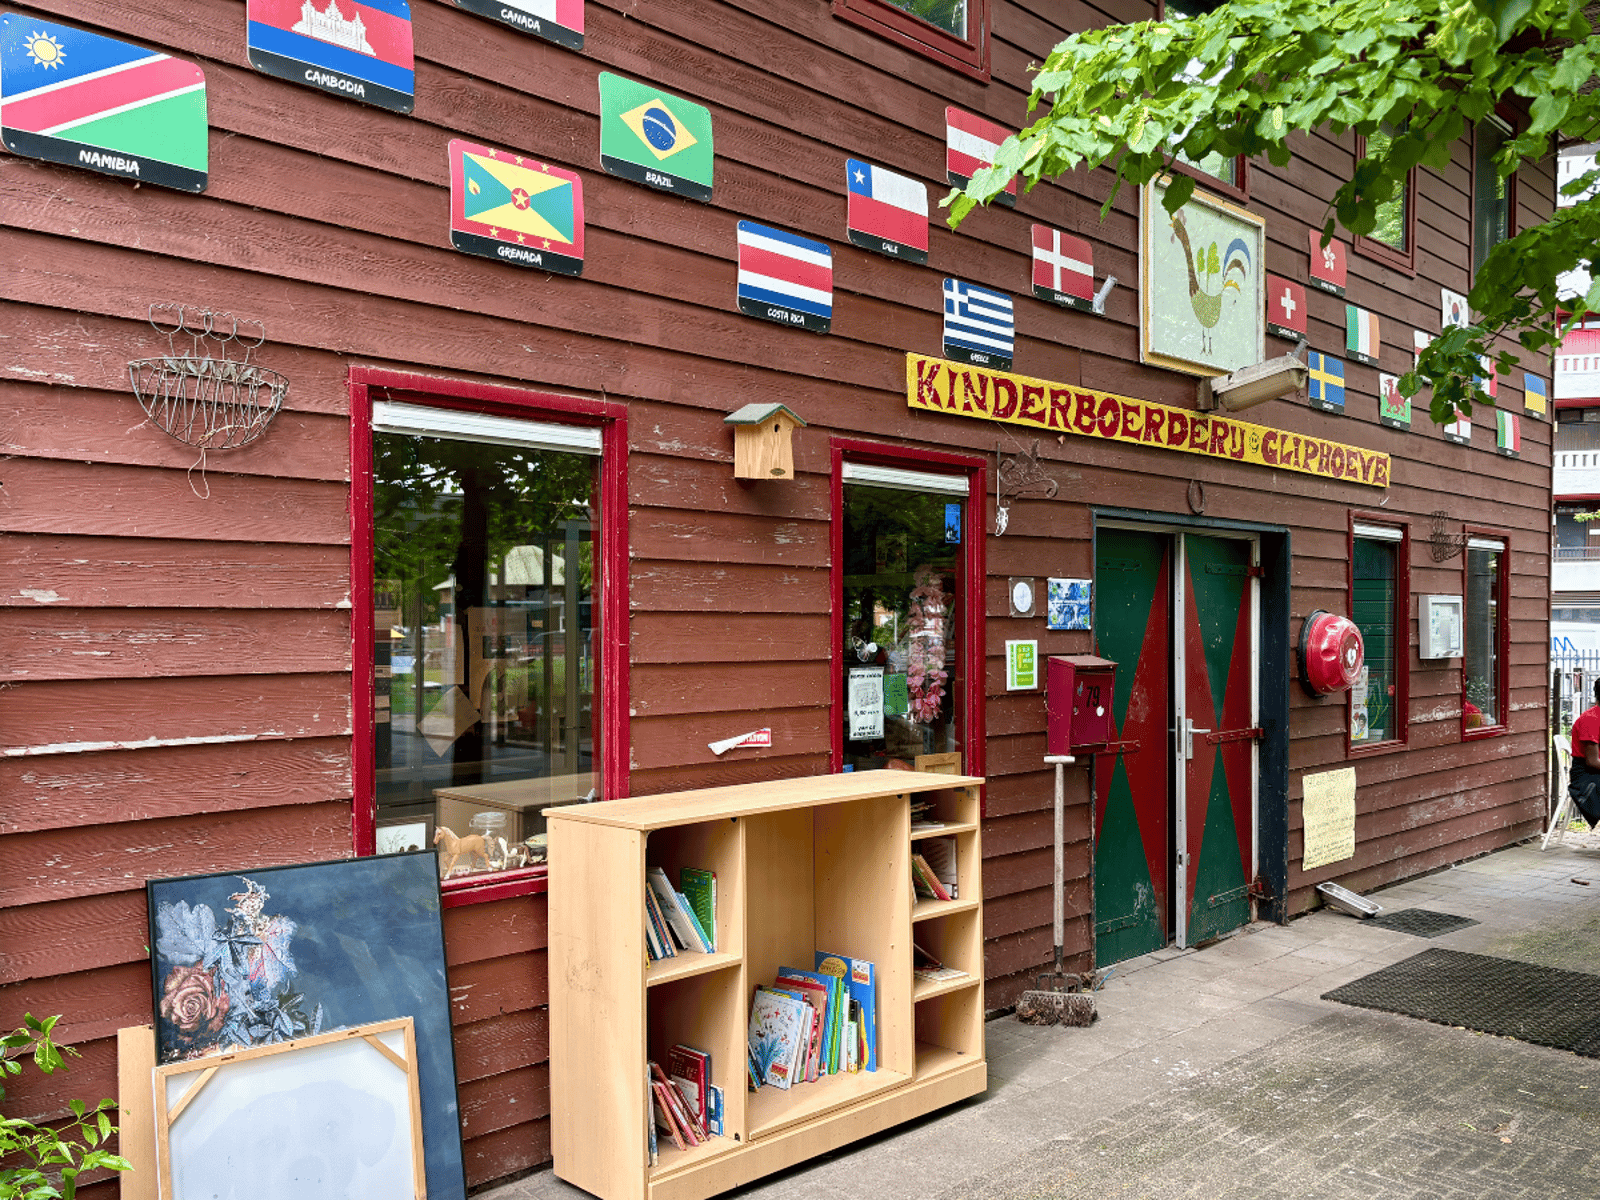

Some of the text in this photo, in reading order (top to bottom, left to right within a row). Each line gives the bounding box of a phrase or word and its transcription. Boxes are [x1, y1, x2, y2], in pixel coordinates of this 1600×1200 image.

[500, 8, 541, 32] CANADA
[304, 69, 365, 98] CAMBODIA
[79, 150, 140, 176] NAMIBIA
[645, 171, 674, 188] BRAZIL
[497, 246, 543, 266] GRENADA
[767, 308, 790, 321] COSTA
[1261, 430, 1388, 486] GLIPHOEVE
[1086, 686, 1100, 708] 79
